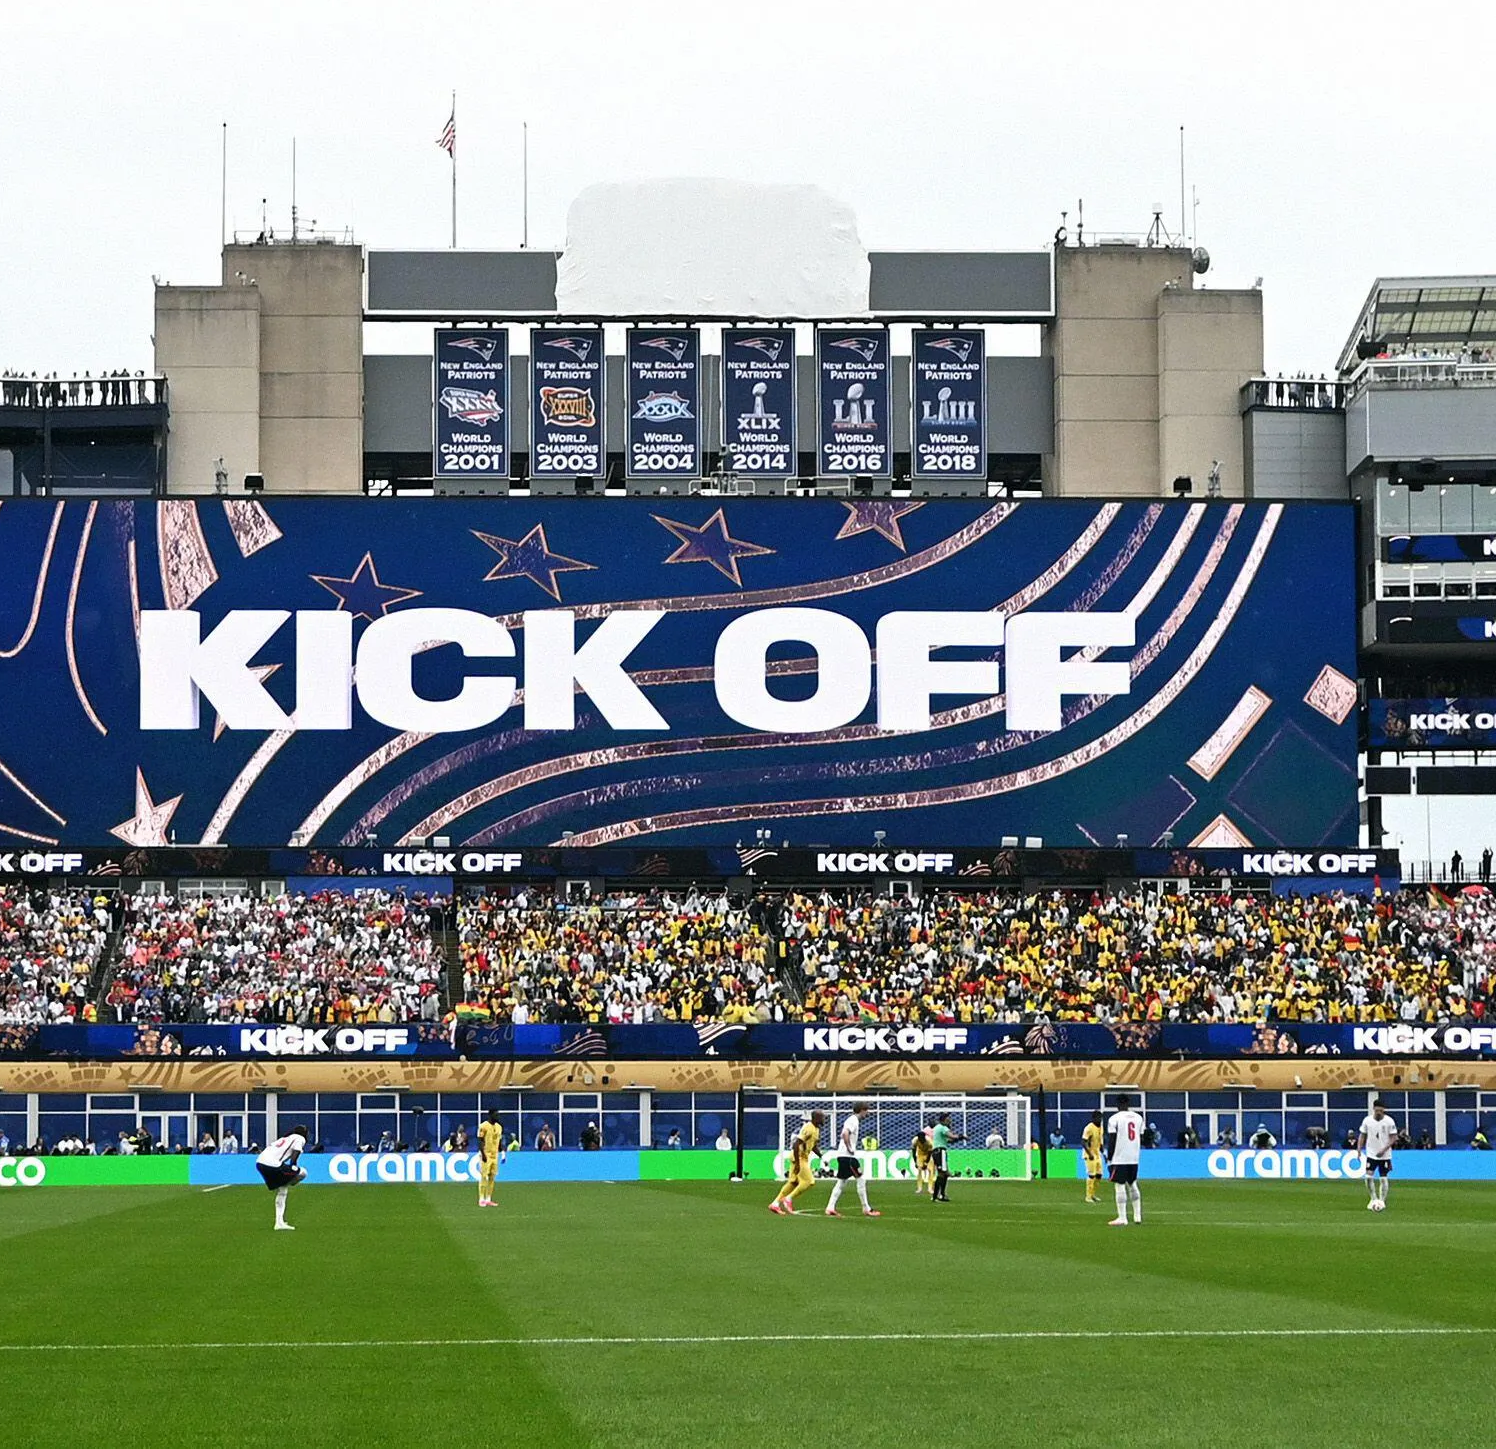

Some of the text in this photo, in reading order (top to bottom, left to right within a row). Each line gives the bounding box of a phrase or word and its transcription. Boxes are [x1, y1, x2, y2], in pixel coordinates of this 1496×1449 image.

[448, 371, 495, 379] PATRIOTS
[544, 371, 591, 379] PATRIOTS
[640, 371, 687, 379] PATRIOTS
[735, 371, 782, 379] PATRIOTS
[831, 371, 877, 379] PATRIOTS
[925, 371, 972, 379] PATRIOTS
[633, 403, 695, 418] XXXIX
[737, 418, 780, 429] XLIX
[452, 433, 491, 442] WORLD
[548, 433, 587, 442] WORLD
[644, 433, 683, 442] WORLD
[740, 433, 778, 442] WORLD
[835, 433, 873, 442] WORLD
[930, 433, 968, 442] WORLD
[440, 444, 502, 453] CHAMPIONS
[537, 444, 598, 453] CHAMPIONS
[633, 444, 694, 453] CHAMPIONS
[729, 444, 790, 453] CHAMPIONS
[824, 444, 885, 453] CHAMPIONS
[919, 444, 980, 453] CHAMPIONS
[444, 454, 499, 470] 2001
[538, 454, 598, 470] 2003
[634, 454, 694, 470] 2004
[732, 454, 787, 470] 2014
[828, 454, 882, 470] 2016
[923, 454, 976, 470] 2018
[140, 607, 1136, 733] KICK OFF
[1410, 713, 1471, 730] KICK
[20, 853, 82, 873] OFF
[383, 853, 522, 872] KICK OFF
[817, 853, 954, 872] KICK OFF
[1243, 853, 1377, 873] KICK OFF
[241, 1028, 409, 1051] KICK OFF
[804, 1027, 968, 1051] KICK OFF
[1353, 1028, 1439, 1051] KICK
[1128, 1122, 1135, 1141] 6
[1207, 1150, 1368, 1179] aramco
